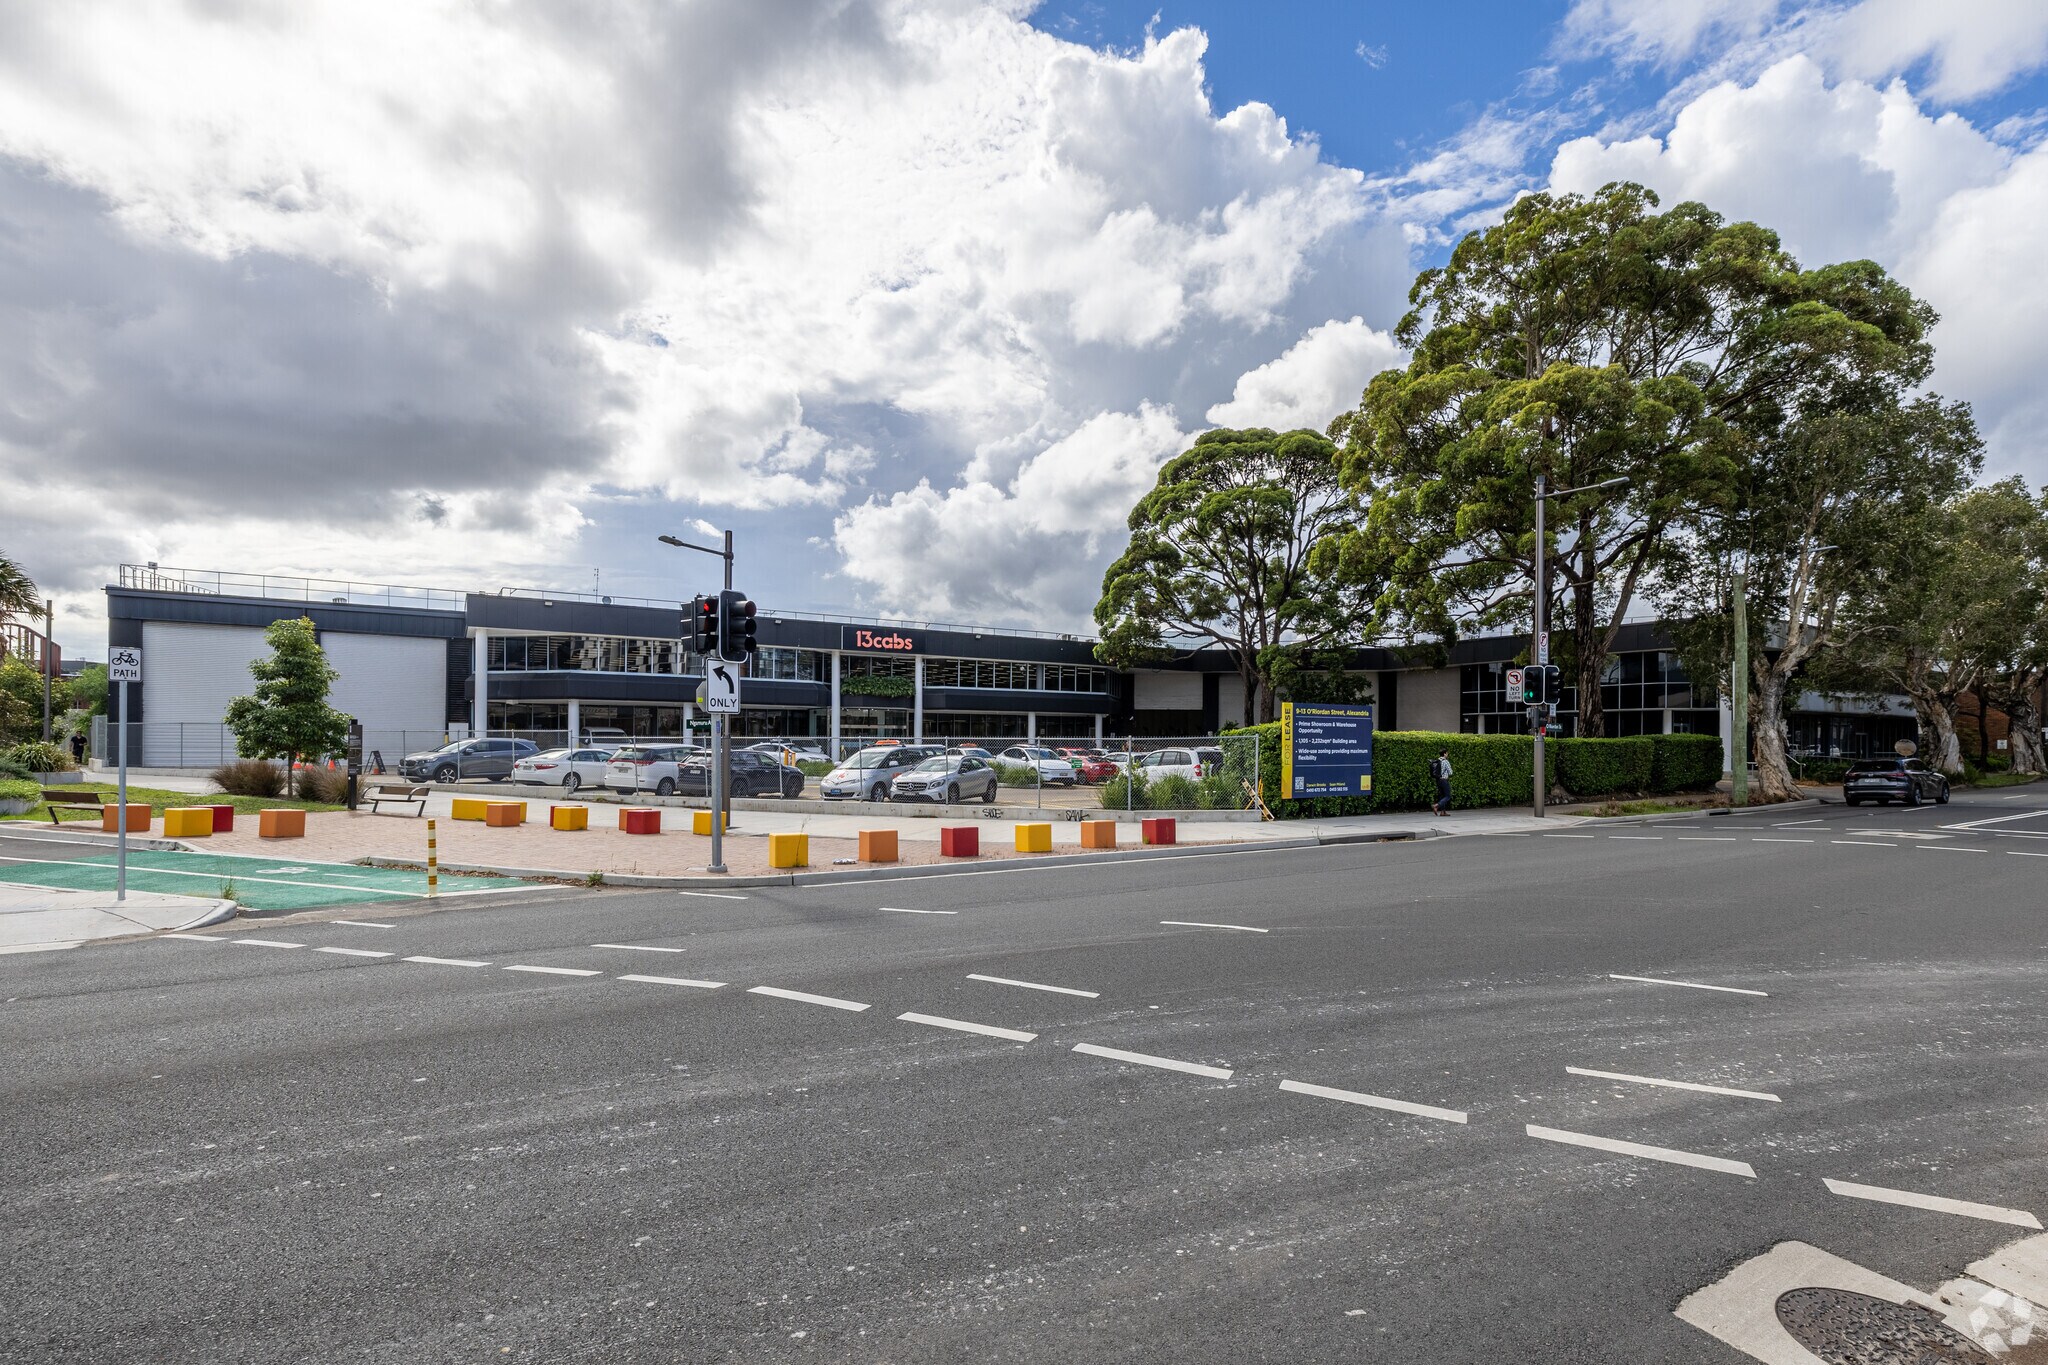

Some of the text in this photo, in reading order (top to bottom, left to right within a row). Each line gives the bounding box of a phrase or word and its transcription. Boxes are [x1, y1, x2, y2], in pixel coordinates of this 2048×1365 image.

[856, 630, 913, 651] 13cabs
[113, 669, 137, 677] PATH
[709, 697, 737, 708] ONLY
